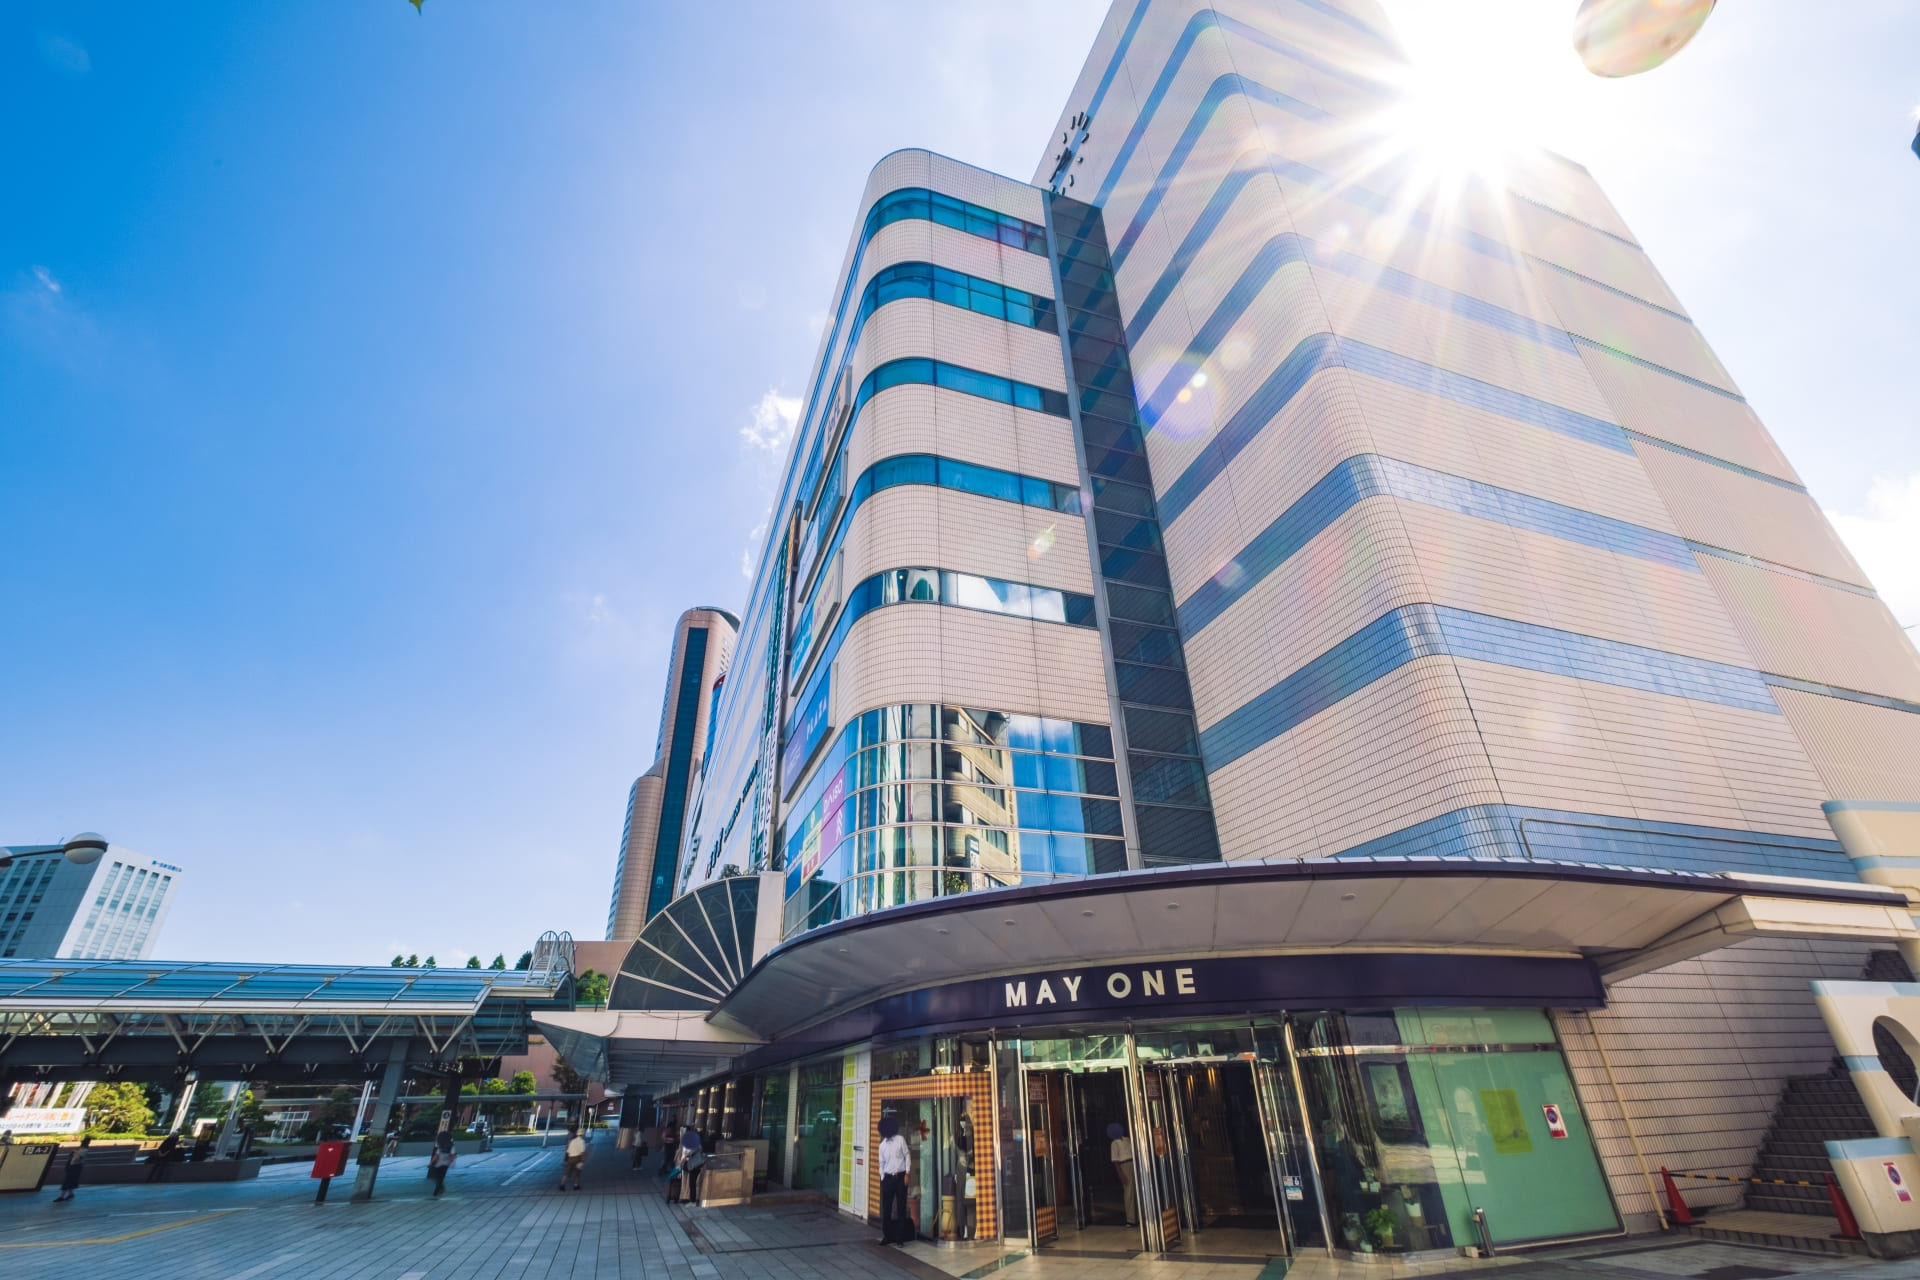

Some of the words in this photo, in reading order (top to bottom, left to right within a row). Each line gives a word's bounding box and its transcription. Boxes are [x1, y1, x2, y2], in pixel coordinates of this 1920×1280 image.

[806, 696, 828, 740] PLAZA
[823, 779, 843, 813] DAISO
[1005, 975, 1082, 1008] MAY
[1106, 967, 1197, 999] ONE
